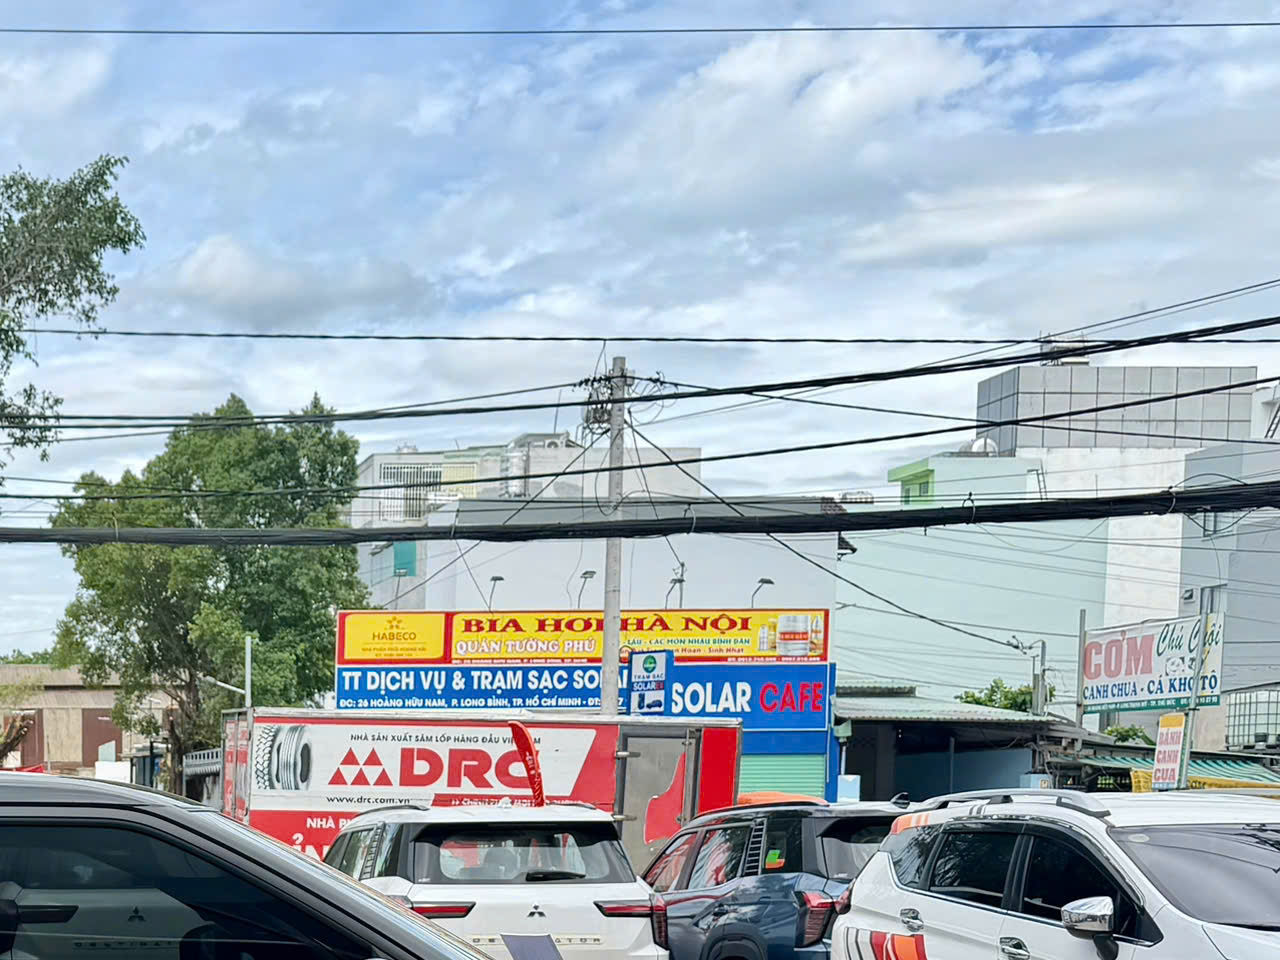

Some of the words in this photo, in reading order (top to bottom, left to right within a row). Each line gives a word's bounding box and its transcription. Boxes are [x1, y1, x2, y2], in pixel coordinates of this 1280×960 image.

[462, 618, 526, 633] BIA
[535, 616, 605, 633] HƠI
[619, 613, 673, 632] HÀ
[681, 613, 752, 635] NỘI
[372, 631, 417, 641] HABECO
[456, 636, 501, 655] QUÁN
[565, 636, 596, 654] PHÚ
[1084, 630, 1154, 681] CƠM
[342, 671, 362, 690] TT
[367, 670, 415, 695] DỊCH
[420, 670, 447, 695] VỤ
[451, 671, 466, 690] &
[471, 670, 522, 695] TRẠM
[527, 670, 569, 694] SẠC
[1083, 684, 1109, 701] CANH
[1112, 680, 1137, 697] CHUA
[1147, 674, 1164, 695] CÁ
[1168, 675, 1193, 694] KHO
[1200, 669, 1218, 694] TỘ
[340, 700, 357, 708] ĐC:
[357, 700, 369, 708] 26
[370, 697, 403, 708] HOÀNG
[405, 698, 424, 708] HỮU
[425, 699, 449, 710] NAM,
[451, 699, 459, 708] P.
[460, 699, 485, 708] LONG
[487, 697, 510, 709] BÌNH,
[512, 698, 524, 708] TP.
[525, 696, 540, 708] HỒ
[541, 696, 557, 707] CHÍ
[558, 698, 582, 707] MINH
[672, 680, 752, 714] SOLAR
[759, 681, 824, 713] CAFE
[350, 731, 368, 742] NHÀ
[371, 732, 388, 742] SẢN
[390, 731, 413, 743] XUẤT
[435, 732, 452, 743] LỐP
[453, 733, 479, 744] HÀNG
[481, 732, 499, 744] ĐẦU
[400, 747, 540, 789] DRC
[1153, 768, 1176, 782] CUA
[326, 795, 410, 805] www.drc.com.vn
[306, 815, 335, 829] NHÀ
